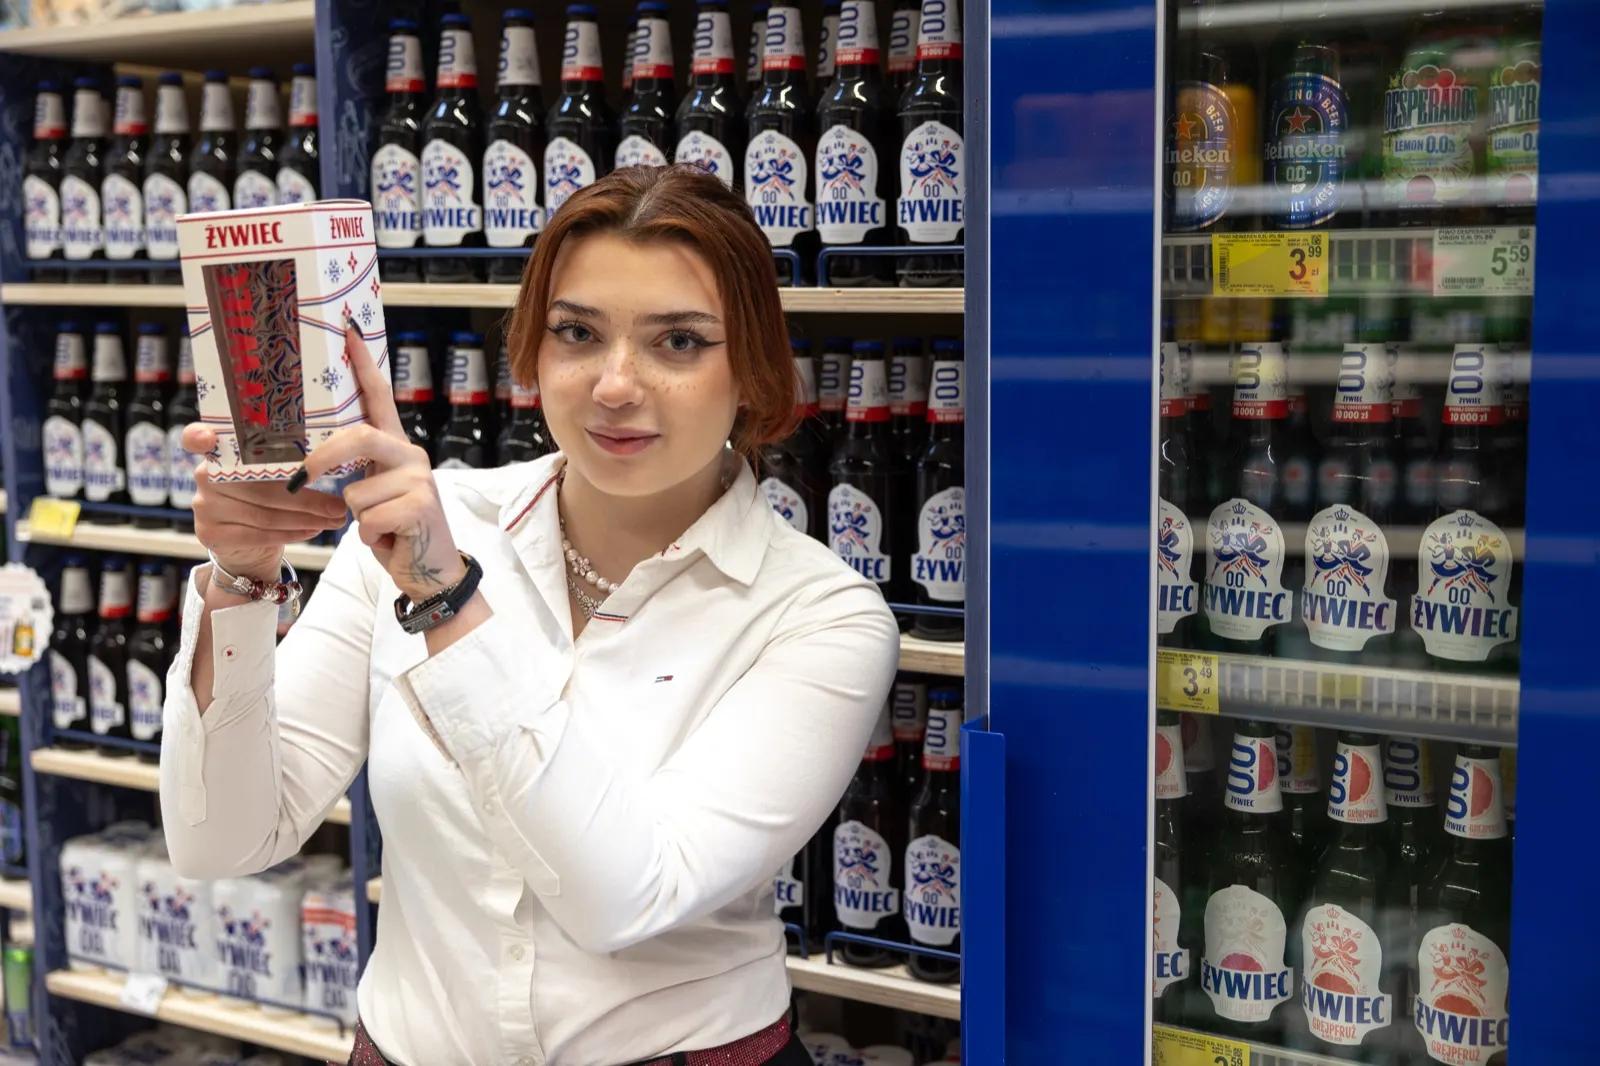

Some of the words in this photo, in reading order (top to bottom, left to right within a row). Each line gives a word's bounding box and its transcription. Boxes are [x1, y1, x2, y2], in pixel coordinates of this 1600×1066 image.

[1206, 104, 1225, 132] BEER
[1321, 98, 1339, 127] BEER
[1164, 145, 1231, 164] ineken
[1264, 140, 1347, 161] Heineken
[1394, 138, 1424, 153] LEMON
[1494, 138, 1521, 150] LEMON
[900, 197, 965, 224] ŻYWIE
[204, 222, 284, 250] ŻYWIEC
[329, 216, 365, 240] ŻYWIEC
[1289, 248, 1307, 281] 3
[1308, 245, 1322, 258] 99
[1491, 246, 1508, 276] 5
[1509, 244, 1530, 263] 59
[1343, 410, 1360, 420] 000
[1360, 411, 1369, 420] zł
[1450, 412, 1459, 422] 10
[1460, 412, 1479, 422] 000
[1479, 413, 1488, 422] zł
[1303, 587, 1390, 632] ŻYWIEC
[1414, 595, 1512, 639] ŻYWIEC
[1183, 667, 1199, 697] 3
[1200, 667, 1213, 679] 49
[1203, 959, 1289, 1001] ŻYWIEC
[1311, 1016, 1357, 1040] GREJPFRUŻ
